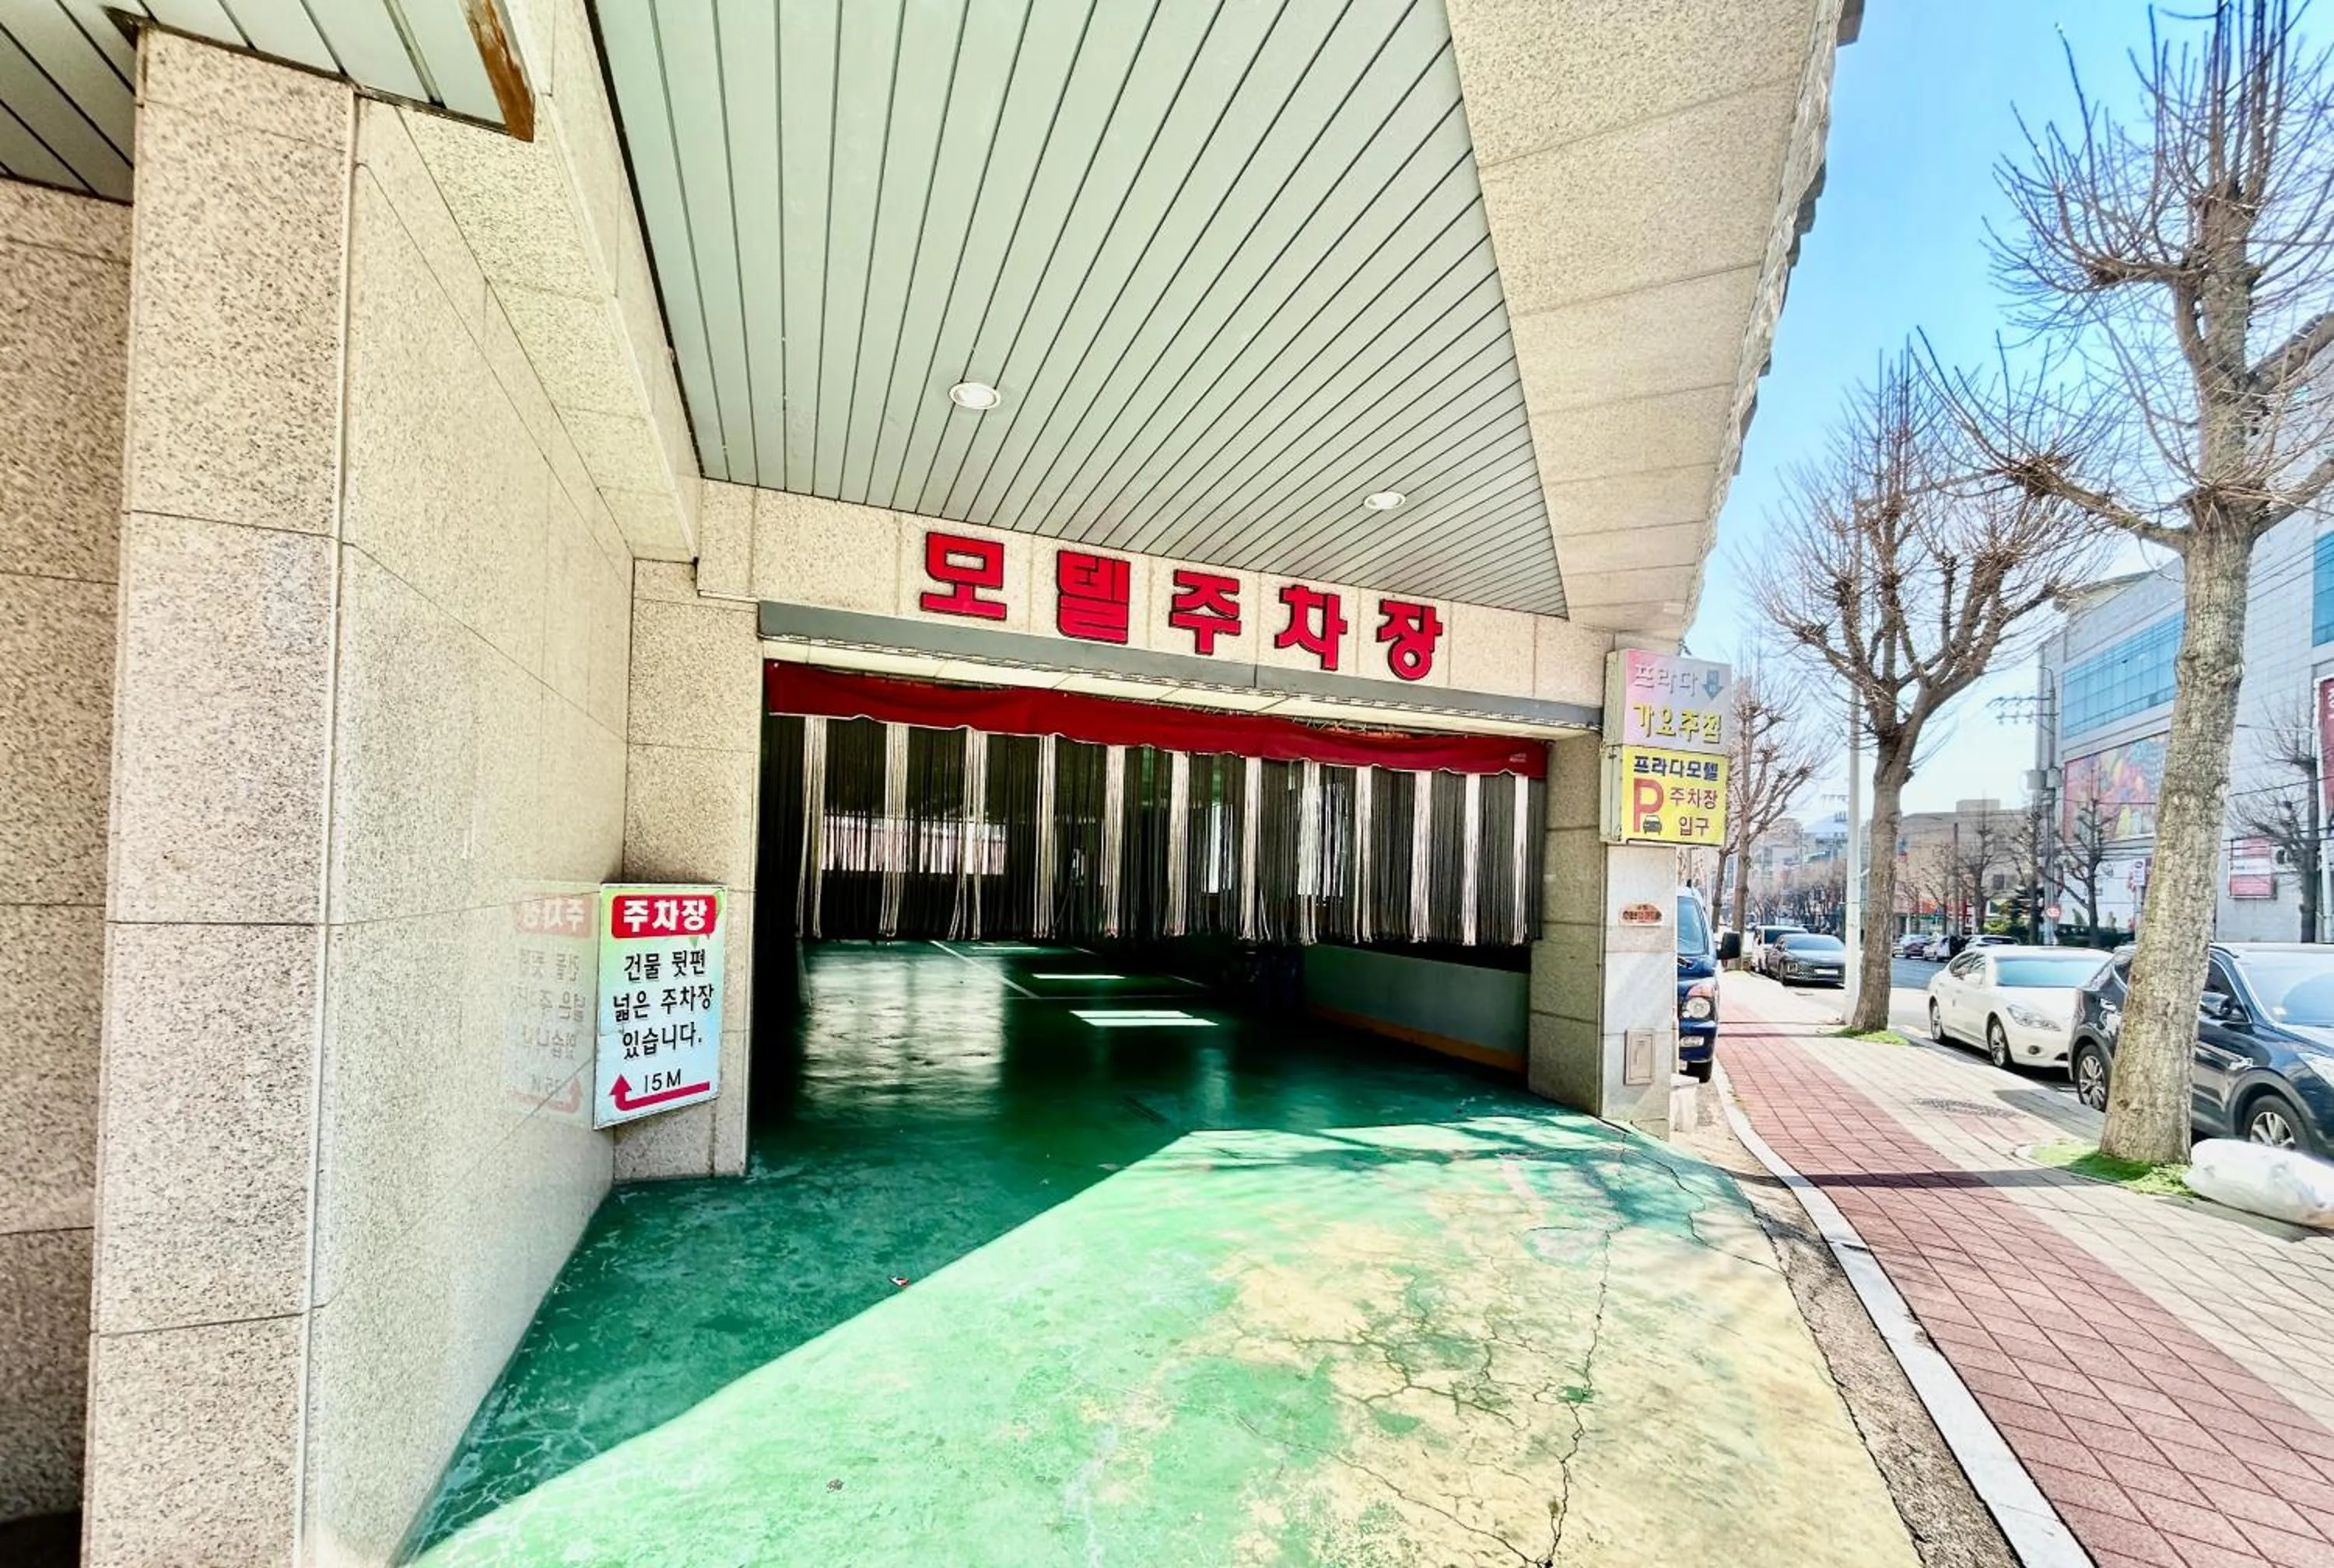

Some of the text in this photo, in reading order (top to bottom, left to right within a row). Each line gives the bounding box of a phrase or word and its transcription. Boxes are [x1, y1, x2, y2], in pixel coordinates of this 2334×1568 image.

[1633, 663, 1699, 698] 프라다
[1632, 703, 1722, 744] 가요주점
[1633, 755, 1719, 782] 프라다모텔
[1633, 777, 1664, 833] P
[1669, 786, 1719, 810] 주차장
[1678, 816, 1710, 837] 입구
[623, 899, 708, 933] 주차장
[623, 948, 706, 982] 건물 뒷편
[613, 989, 650, 1023] 넓은
[661, 983, 715, 1015] 주차장
[622, 1021, 703, 1061] 있습니다.
[644, 1069, 682, 1094] 15M
